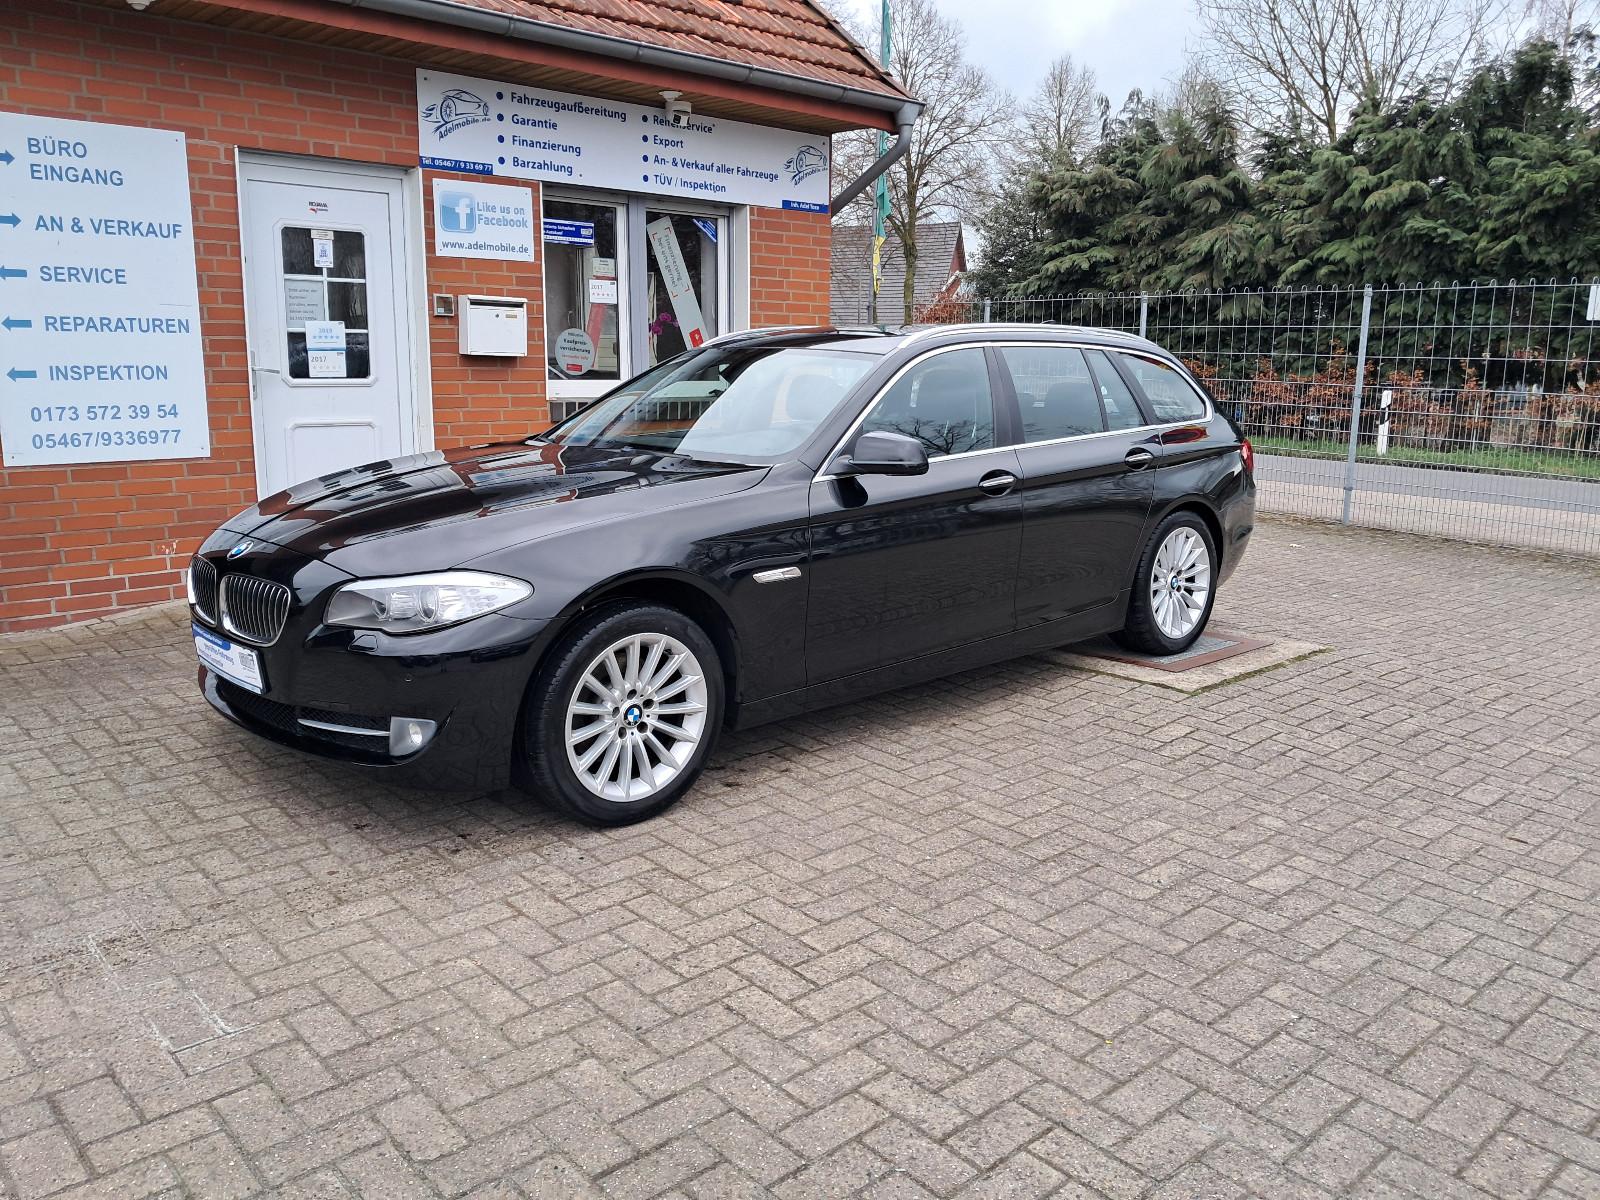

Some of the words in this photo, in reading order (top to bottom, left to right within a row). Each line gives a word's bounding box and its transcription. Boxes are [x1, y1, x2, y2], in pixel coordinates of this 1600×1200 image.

[511, 92, 627, 122] Fahrzeugaufbereitung
[511, 114, 558, 130] Garantie
[26, 136, 88, 159] BÜRO
[512, 135, 581, 156] Finanzierung
[653, 135, 684, 149] Export
[434, 159, 455, 167] 05467
[512, 157, 573, 176] Barzahlung
[653, 155, 670, 165] An-
[671, 157, 679, 167] &
[680, 158, 714, 172] Verkauf
[716, 164, 734, 175] aller
[736, 166, 779, 183] Fahrzeuge
[30, 163, 124, 187] EINGANG
[653, 173, 673, 186] TÜV
[680, 178, 726, 193] Inspektion
[476, 201, 497, 213] Like
[500, 205, 511, 215] us
[513, 207, 525, 215] on
[35, 215, 64, 233] AN
[70, 216, 85, 234] &
[90, 218, 183, 240] VERKAUF
[478, 214, 528, 228] Facebook
[442, 241, 529, 253] www.adelmobile.de
[39, 265, 128, 285] SERVICE
[44, 315, 191, 334] REPARATUREN
[49, 365, 168, 381] INSPEKTION
[30, 406, 80, 423] 0173
[87, 405, 122, 421] 572
[128, 404, 151, 420] 39
[157, 403, 179, 419] 54
[31, 429, 182, 450] 05467/9336977
